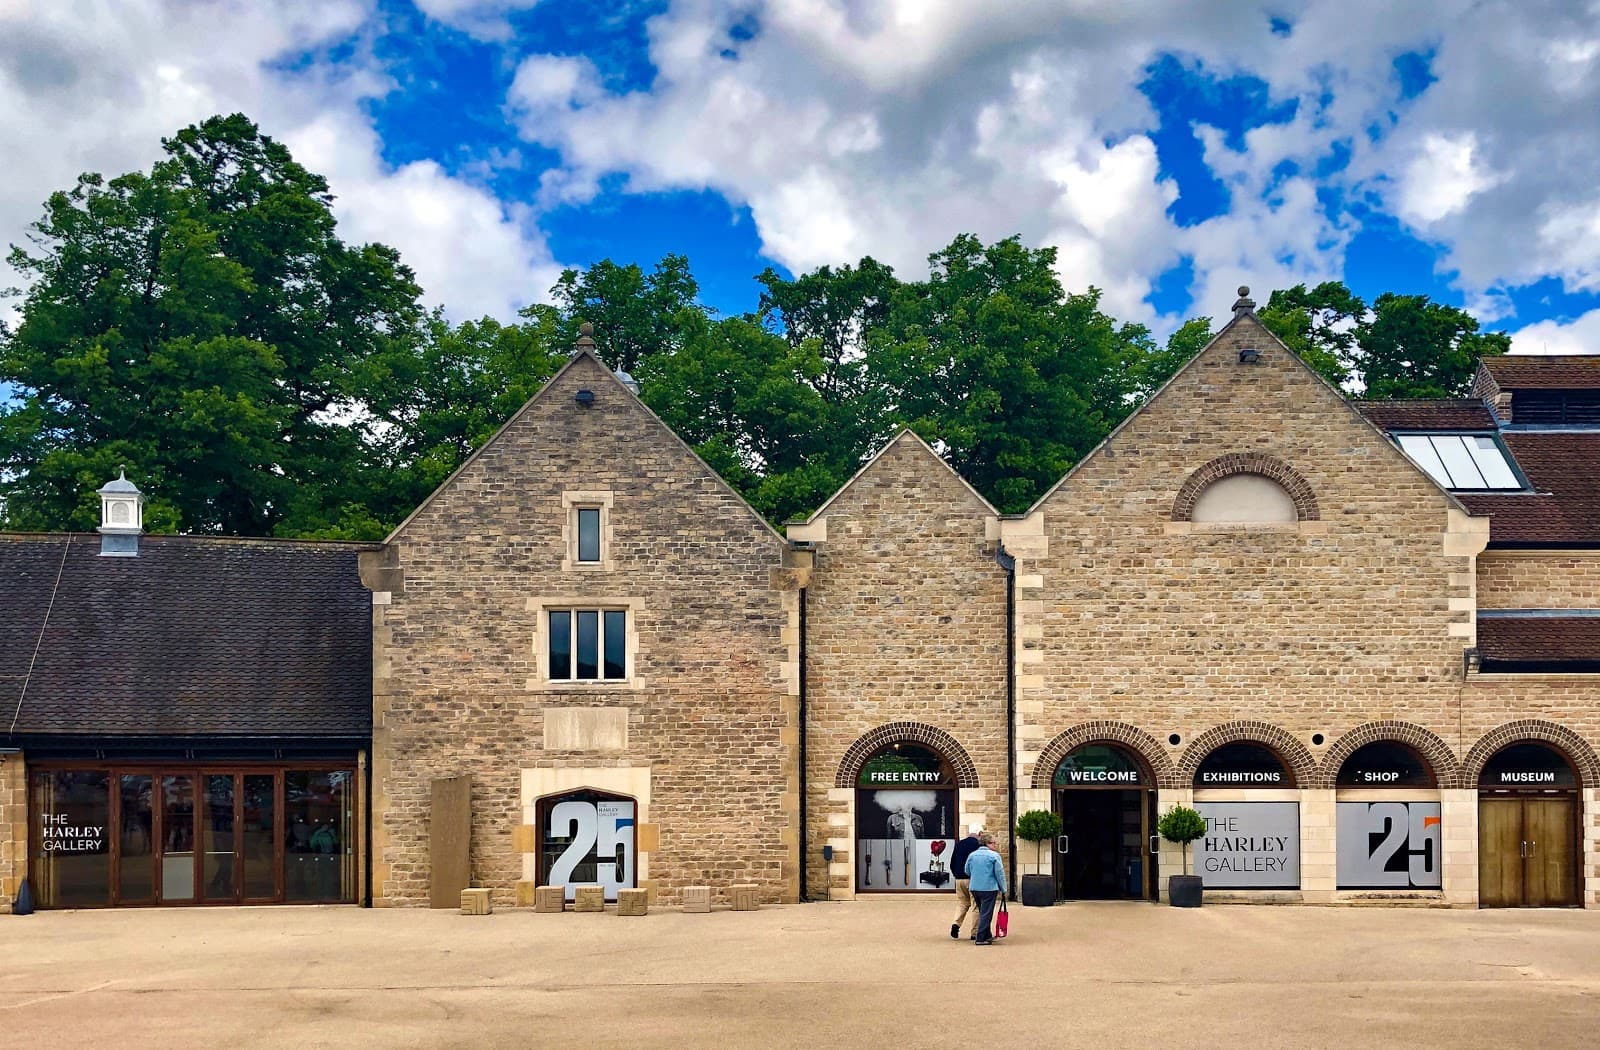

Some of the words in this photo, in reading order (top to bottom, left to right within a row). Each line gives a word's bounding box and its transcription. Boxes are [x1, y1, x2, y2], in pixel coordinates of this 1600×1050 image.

[871, 772, 899, 782] FREE
[902, 772, 941, 782] ENTRY
[1070, 771, 1138, 781] WELCOME
[1203, 772, 1281, 782] EXHIBITIONS
[1364, 772, 1399, 782] SHOP
[1501, 772, 1555, 782] MUSEUM
[42, 813, 68, 825] THE
[1204, 817, 1239, 832] THE
[43, 826, 103, 838] HARLEY
[42, 839, 103, 851] GALLERY
[1204, 836, 1289, 852] HARLEY
[1368, 802, 1440, 887] 25
[549, 801, 634, 900] 25
[1204, 857, 1288, 872] GALLERY
